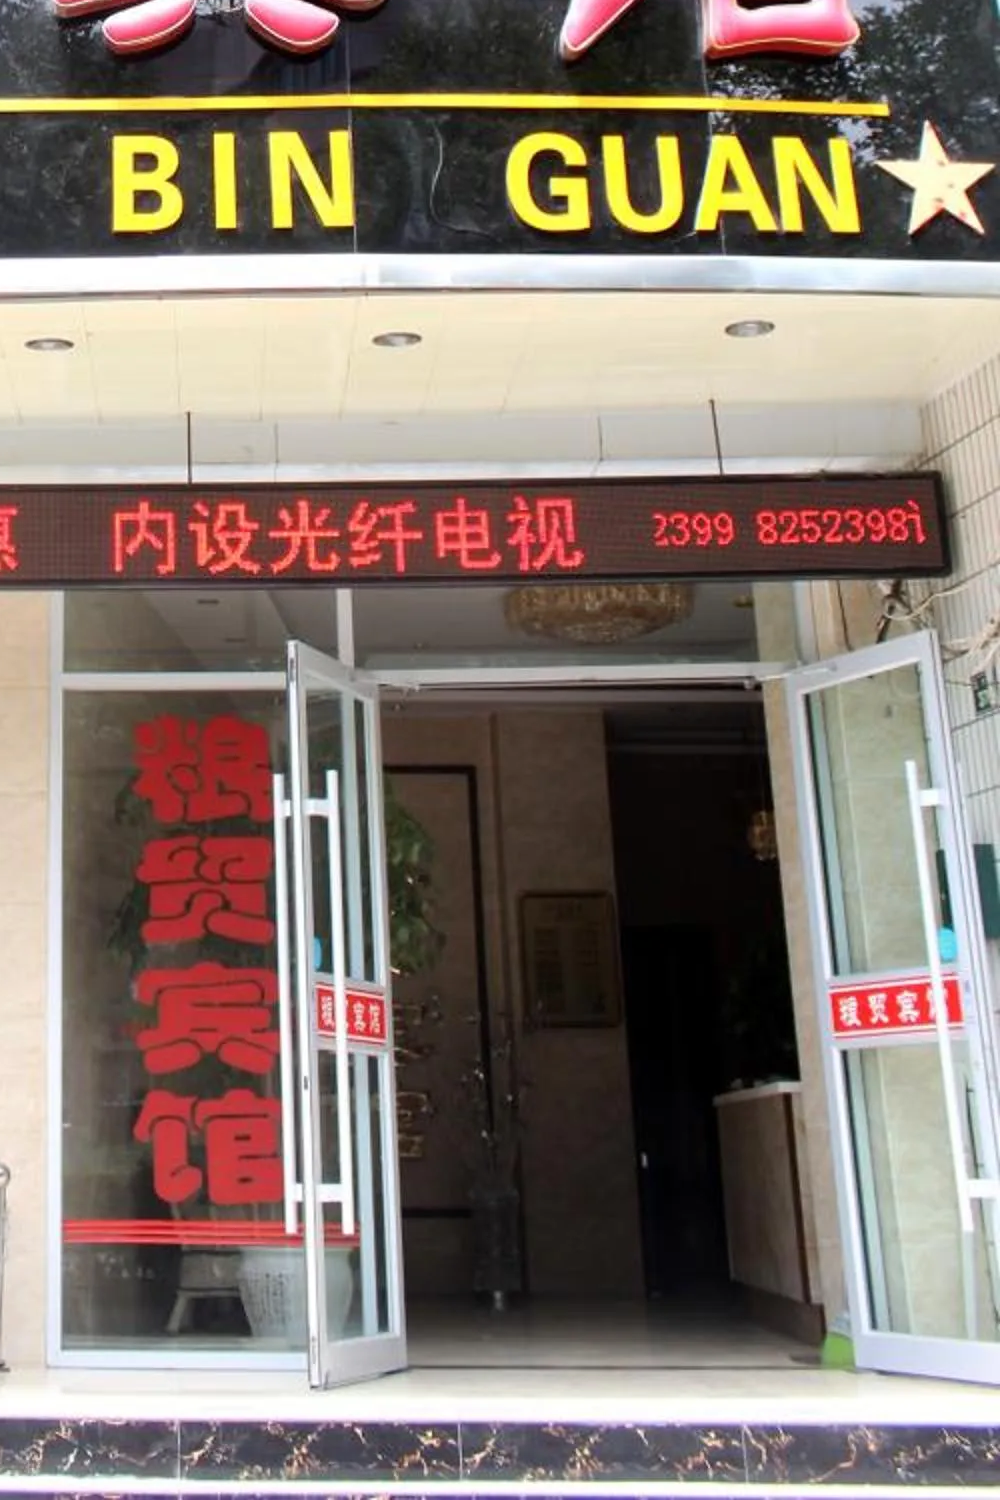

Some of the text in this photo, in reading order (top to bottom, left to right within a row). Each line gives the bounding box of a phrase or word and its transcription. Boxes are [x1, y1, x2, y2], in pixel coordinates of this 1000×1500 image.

[110, 128, 356, 236] BIN
[505, 132, 862, 236] GUAN
[111, 497, 585, 575] 内设光纤电视
[132, 713, 284, 1204] 粮贸宾馆
